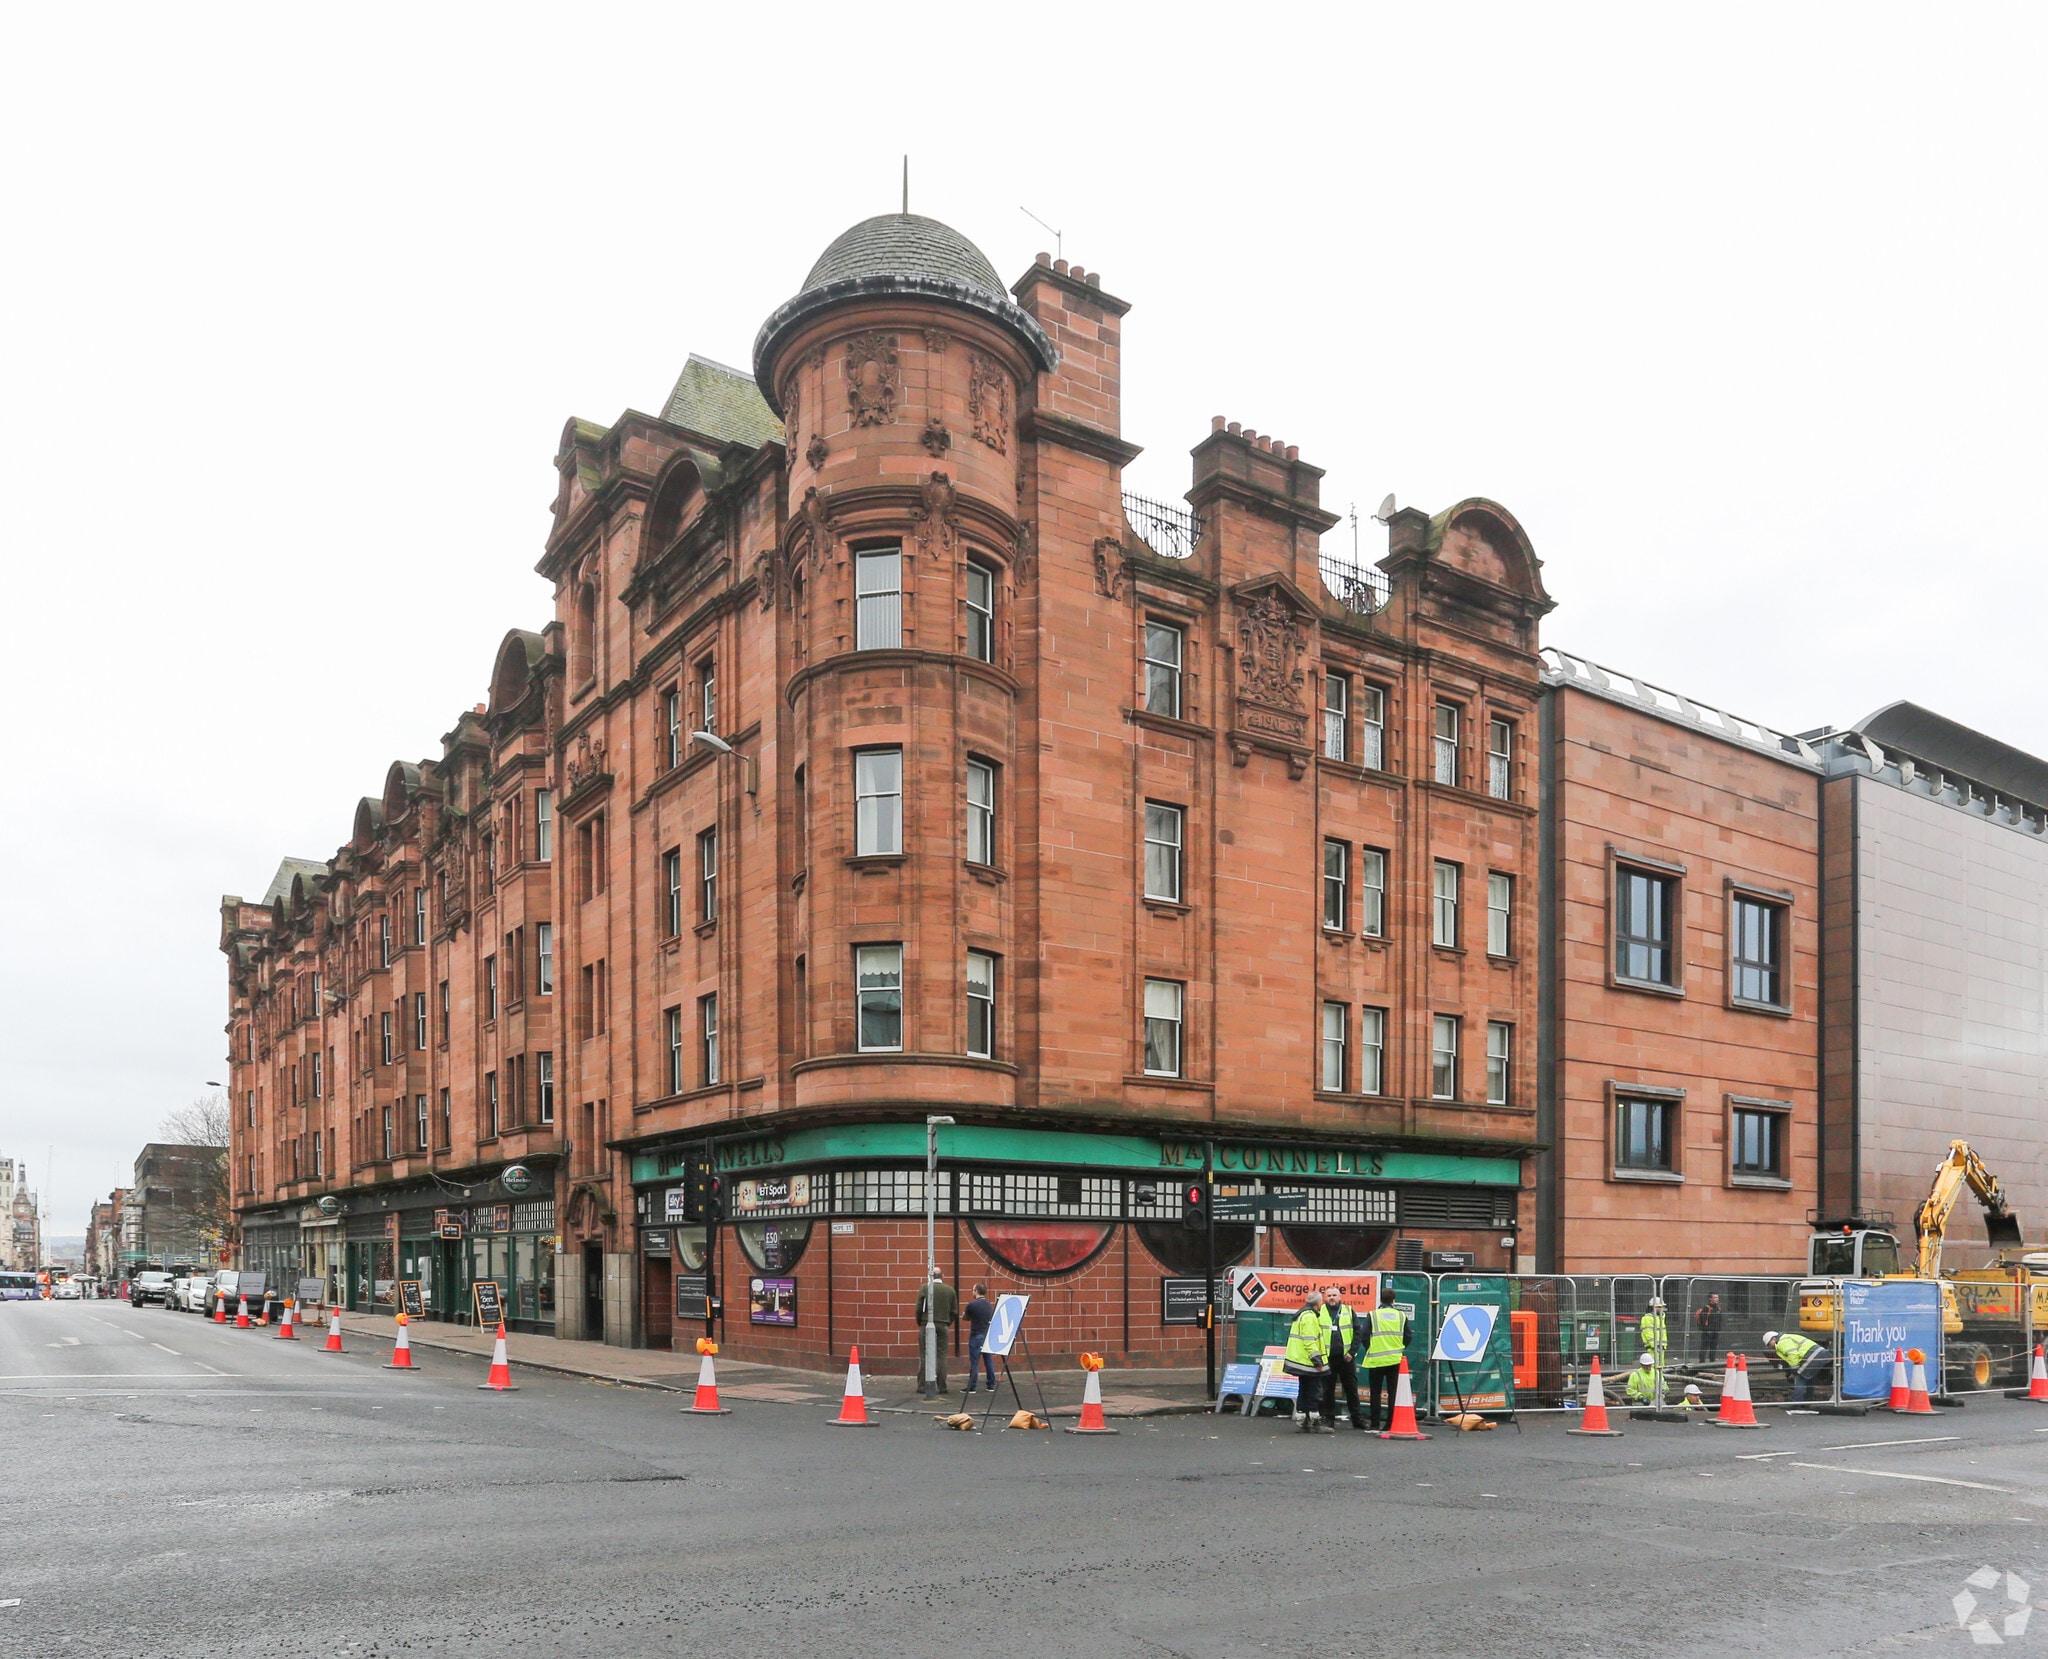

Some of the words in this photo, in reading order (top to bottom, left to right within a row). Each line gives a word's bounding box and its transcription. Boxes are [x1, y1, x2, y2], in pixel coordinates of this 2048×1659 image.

[759, 1186, 769, 1196] BT
[769, 1184, 787, 1197] Sport
[669, 1194, 681, 1208] sky
[766, 1232, 778, 1244] £50
[1270, 1281, 1309, 1296] George
[1350, 1283, 1370, 1295] Ltd
[1850, 1320, 1884, 1343] Thank
[1886, 1326, 1906, 1348] you
[1849, 1348, 1860, 1364] for
[1861, 1351, 1880, 1368] your
